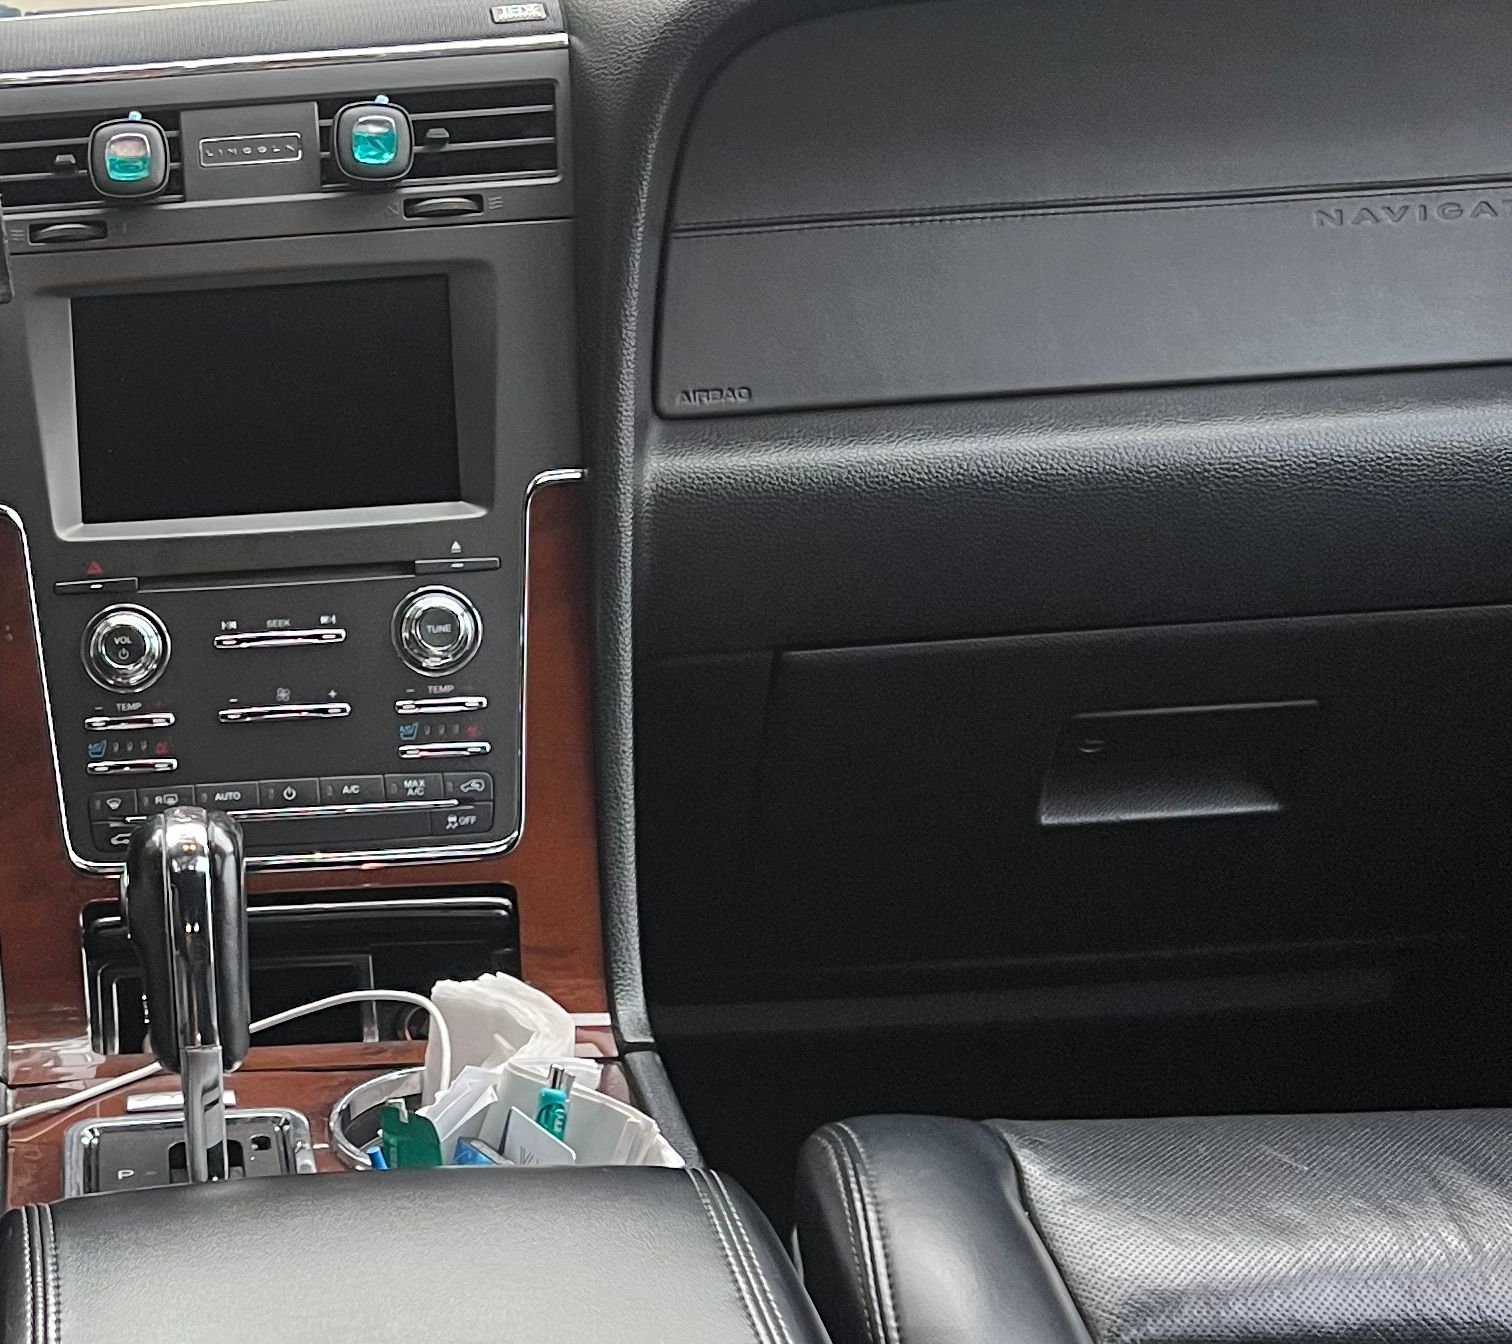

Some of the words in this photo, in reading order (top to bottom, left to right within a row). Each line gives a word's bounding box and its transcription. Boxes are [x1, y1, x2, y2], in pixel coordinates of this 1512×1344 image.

[676, 386, 753, 408] AIRBAG
[266, 618, 291, 628] SEEK
[426, 623, 452, 633] TUNE
[114, 636, 132, 645] VOL
[427, 685, 454, 694] TEMP
[116, 702, 142, 712] TEMP
[403, 779, 425, 788] MAX
[342, 784, 360, 795] A/C
[407, 786, 424, 796] A/C
[214, 791, 241, 801] AUTO
[458, 815, 477, 826] OFF
[117, 1168, 135, 1180] P
